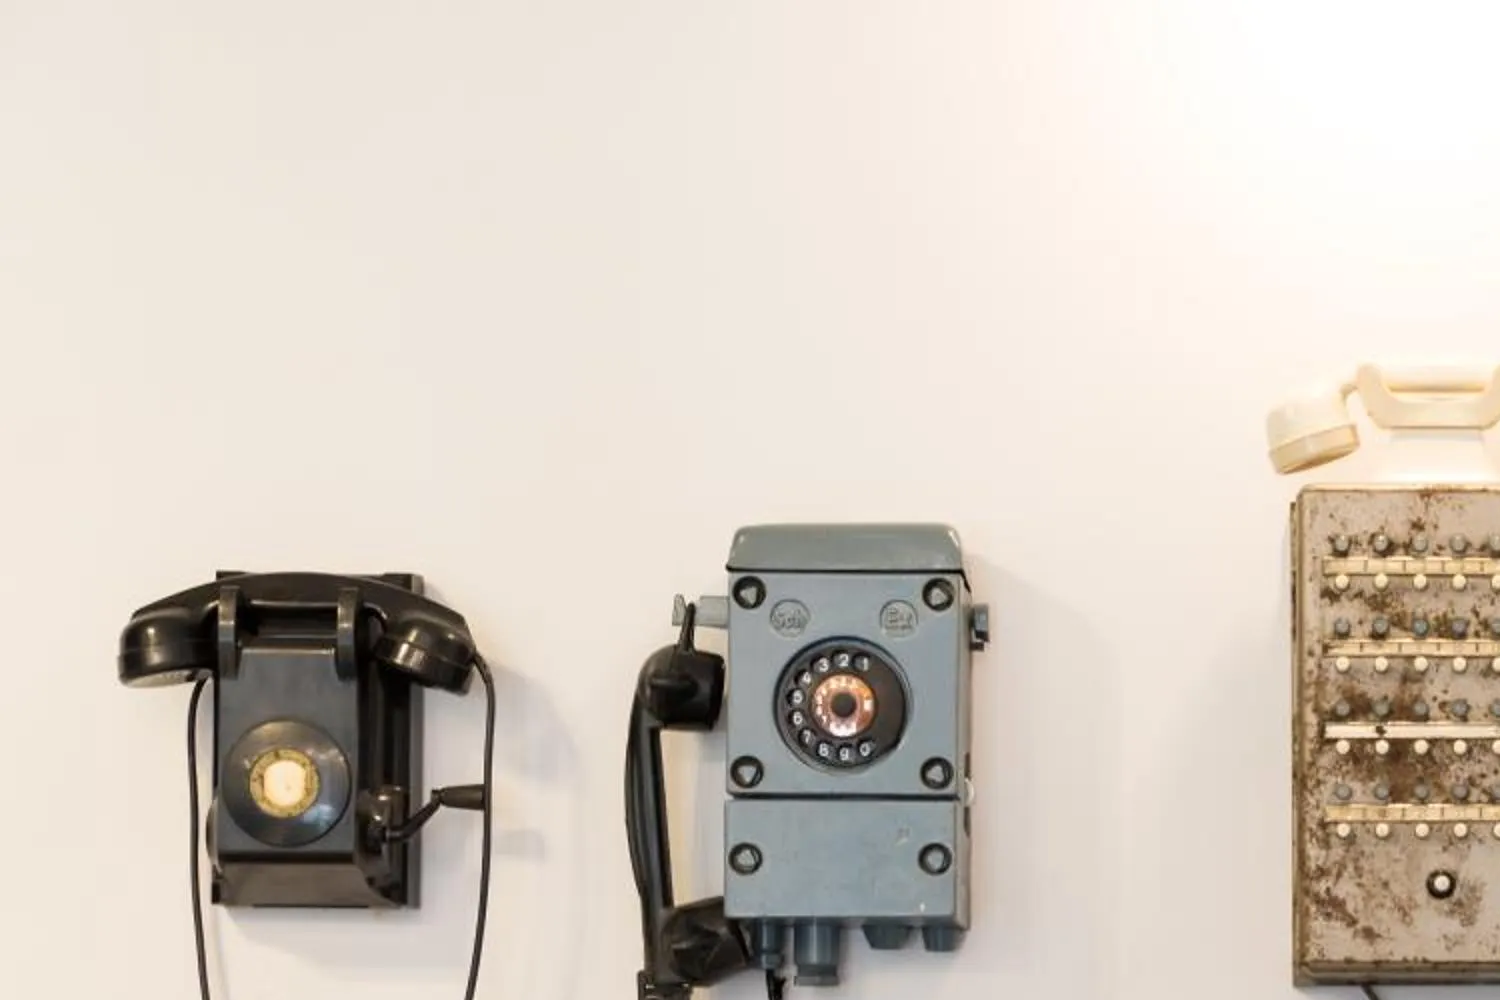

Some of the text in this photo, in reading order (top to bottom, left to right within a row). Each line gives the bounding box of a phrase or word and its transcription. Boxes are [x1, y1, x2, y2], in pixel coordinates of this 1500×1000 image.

[820, 657, 829, 672] 3
[839, 653, 849, 667] 2
[862, 657, 869, 671] 1
[802, 671, 811, 684] 4
[793, 711, 803, 725] 6
[803, 730, 811, 743] 7
[840, 747, 849, 760] 9
[860, 742, 870, 757] 0
